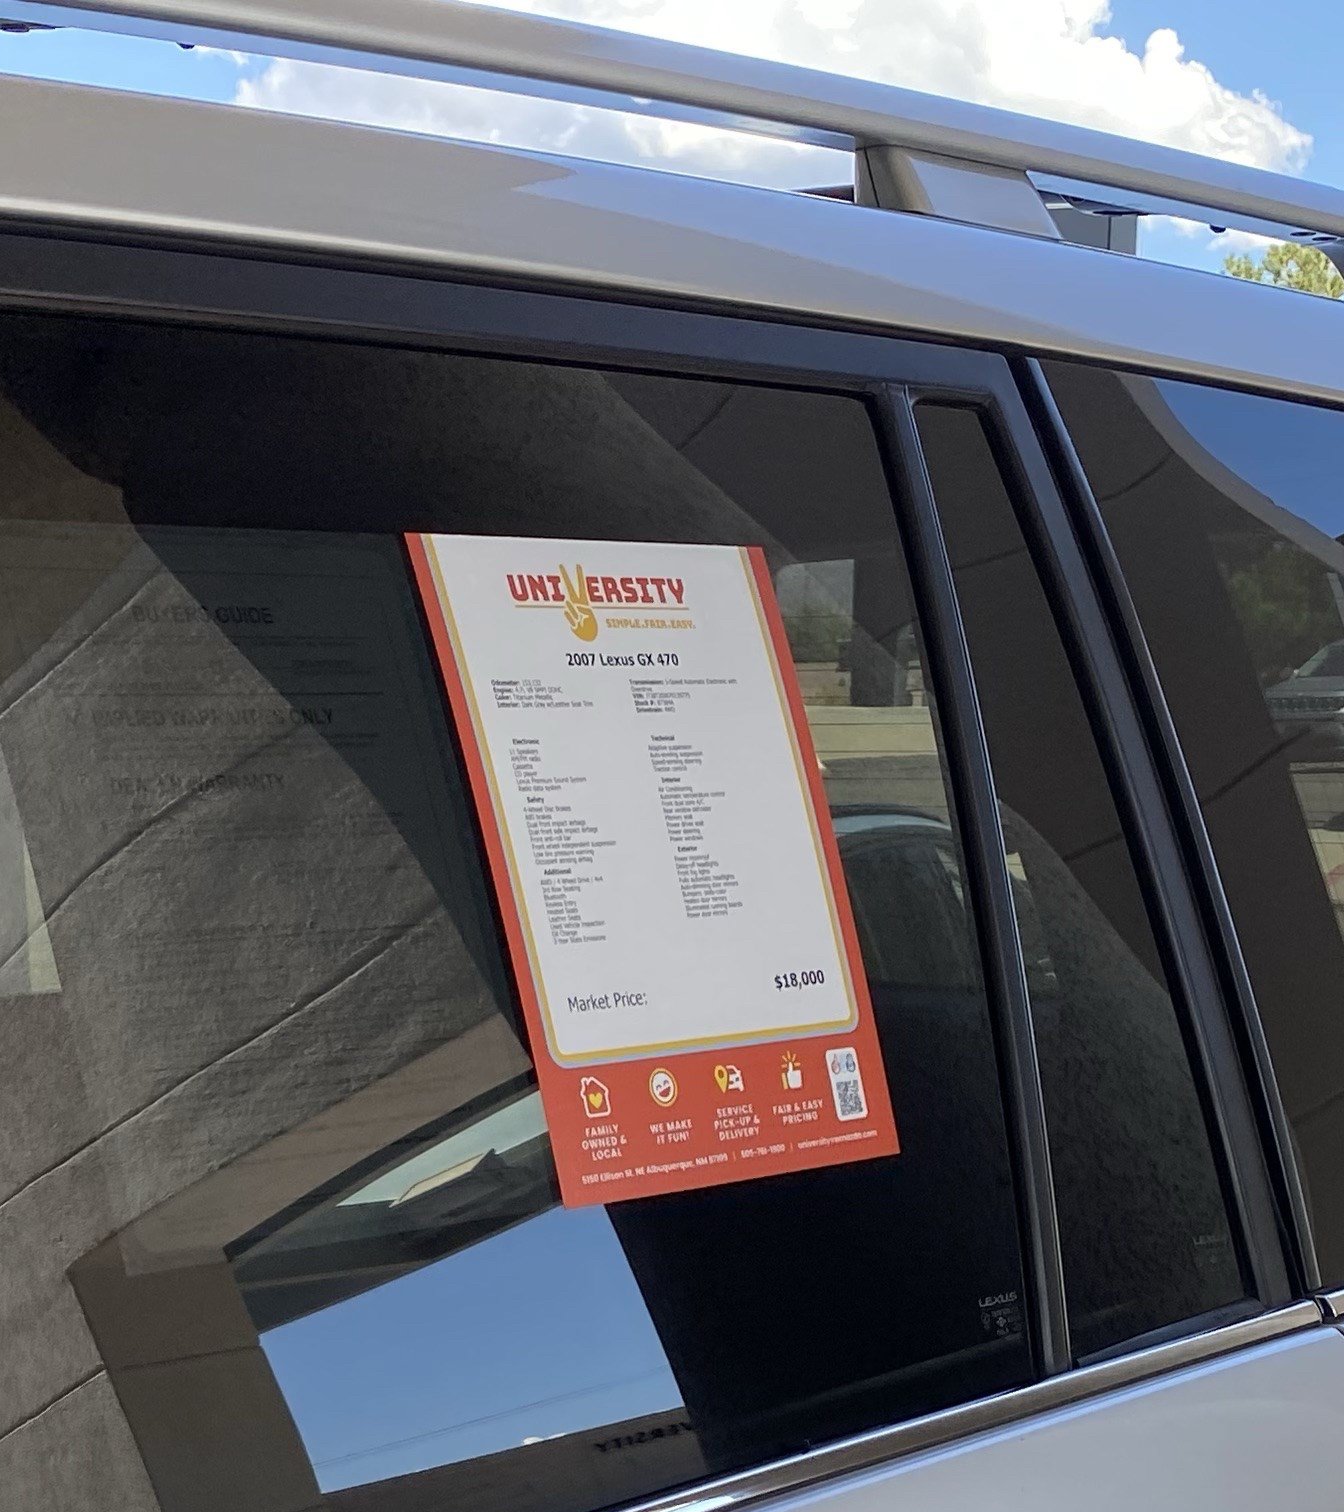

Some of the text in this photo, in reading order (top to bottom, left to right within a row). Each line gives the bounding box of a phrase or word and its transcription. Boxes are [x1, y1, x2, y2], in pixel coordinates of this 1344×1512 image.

[508, 574, 683, 604] UNIVERSITY
[565, 653, 679, 667] 2007 Lexus GX 470
[774, 970, 825, 990] $18,000
[567, 992, 648, 1012] Market Price:
[716, 1103, 753, 1118] SERVICE
[772, 1103, 792, 1115] FAIR
[802, 1099, 823, 1110] EASY
[713, 1115, 751, 1130] PICK-UP
[782, 1111, 818, 1125] PRICING
[585, 1124, 618, 1137] FAMILY
[649, 1119, 692, 1134] WE MAKE
[718, 1126, 759, 1141] DELIVERY
[581, 1136, 618, 1150] OWNED
[656, 1134, 665, 1145] IT
[591, 1148, 622, 1161] LOCAL
